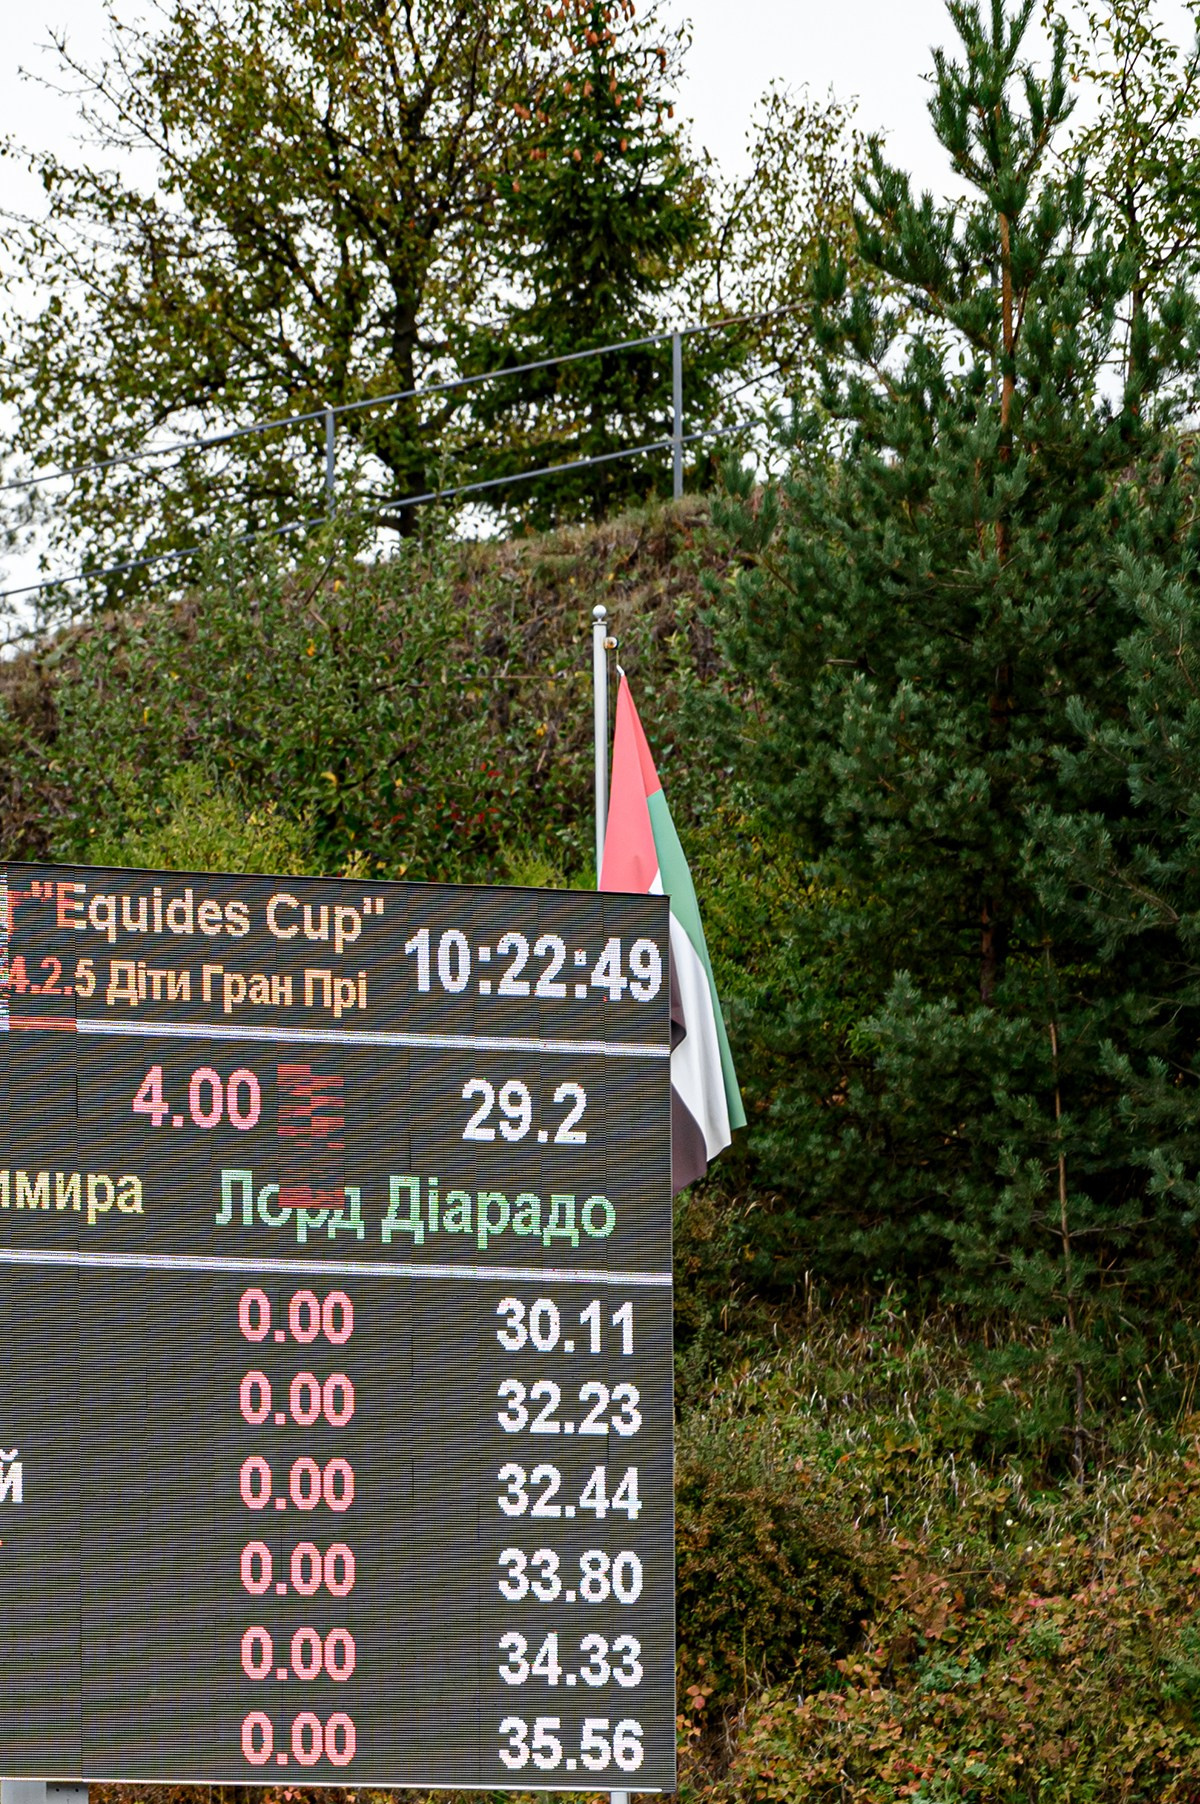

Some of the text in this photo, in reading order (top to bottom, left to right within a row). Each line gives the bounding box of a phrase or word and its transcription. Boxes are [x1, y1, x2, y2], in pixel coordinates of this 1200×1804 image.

[31, 881, 251, 943] "Equides
[266, 893, 385, 953] Cup"
[106, 960, 192, 1007] Діти
[201, 963, 293, 1015] Гран
[303, 968, 368, 1018] Прі
[404, 929, 662, 1003] 10:22:49
[132, 1065, 263, 1131] 4.00
[461, 1078, 588, 1146] 29.2
[215, 1169, 617, 1250] Лорд Діарадо
[238, 1287, 355, 1344] 0.00
[496, 1297, 634, 1356] 30.11
[238, 1370, 356, 1427] 0.00
[496, 1379, 643, 1436] 32.23
[239, 1455, 356, 1512] 0.00
[497, 1463, 643, 1520] 32.44
[240, 1541, 356, 1597] 0.00
[498, 1547, 644, 1604] 33.80
[240, 1626, 357, 1681] 0.00
[498, 1631, 644, 1687] 34.33
[241, 1711, 357, 1766] 0.00
[498, 1716, 645, 1772] 35.56
